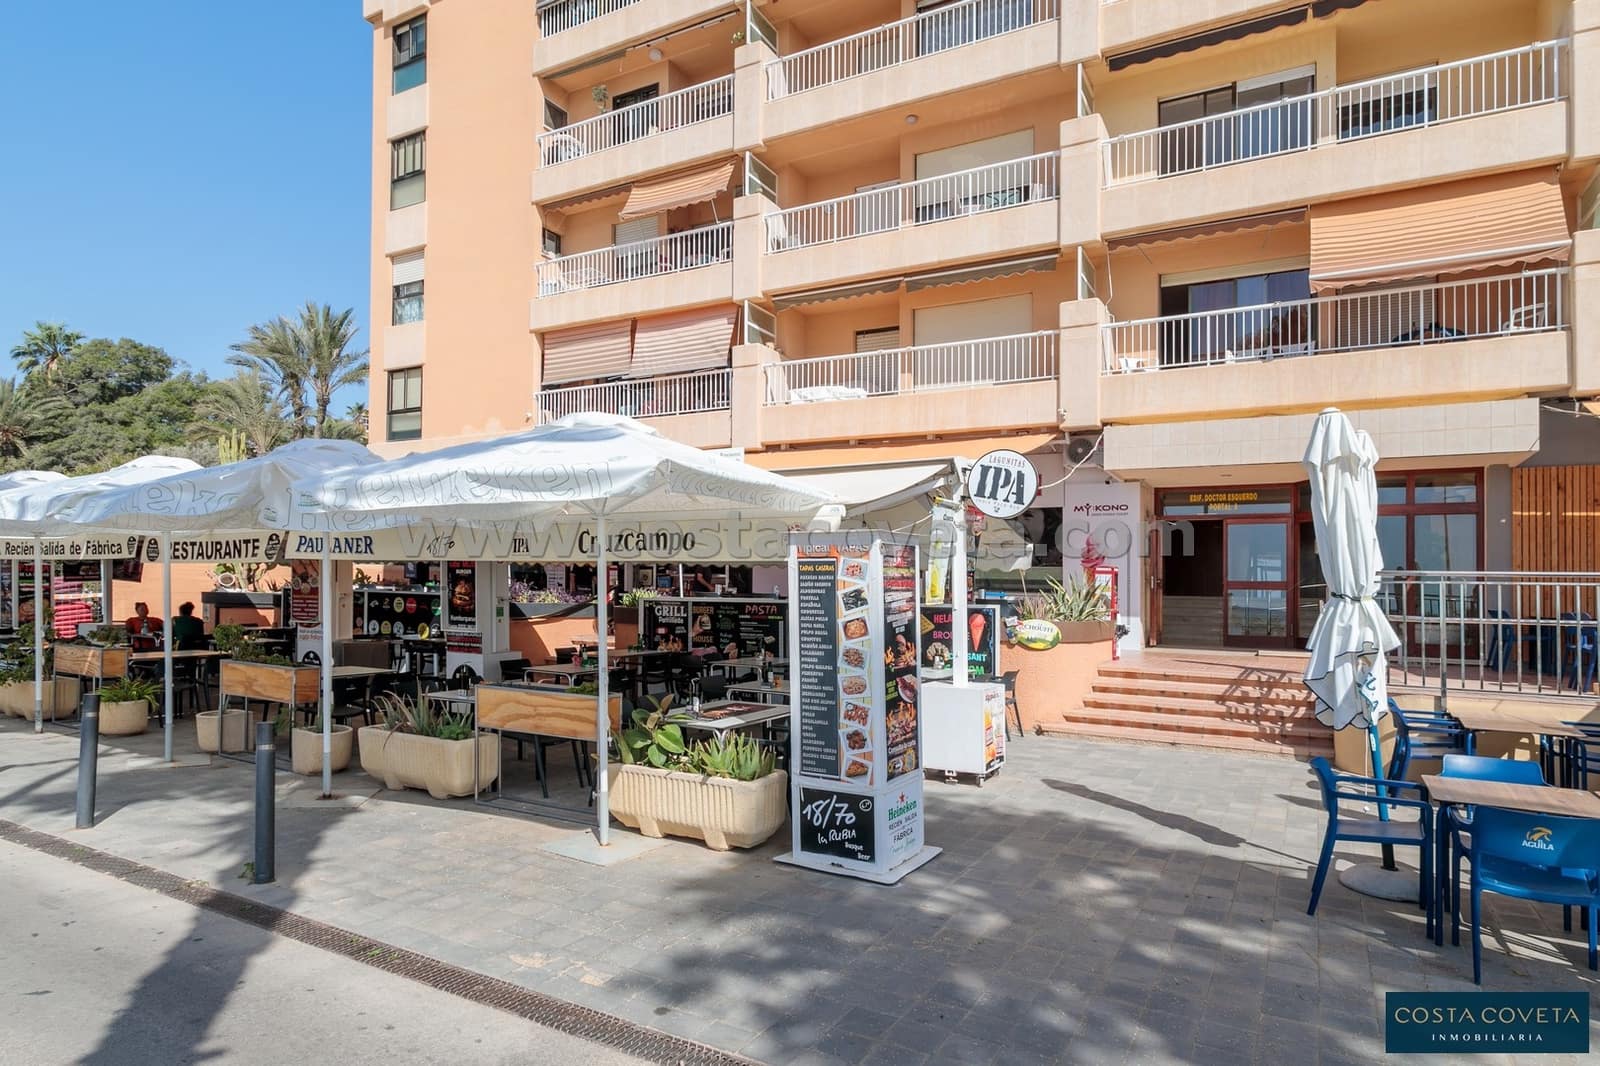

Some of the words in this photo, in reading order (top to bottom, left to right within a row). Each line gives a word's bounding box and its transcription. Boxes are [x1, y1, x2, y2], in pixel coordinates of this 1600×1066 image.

[989, 455, 1026, 468] LAGUNITAS
[974, 464, 1025, 505] IPA
[1204, 493, 1227, 502] DOCTOR
[5, 542, 35, 555] Recién
[69, 541, 81, 555] de
[86, 539, 123, 554] Fábrica
[296, 535, 374, 555] PAUANER
[513, 538, 530, 553] IPA
[578, 530, 696, 555] Cruzcampo
[654, 605, 687, 617] GRILL
[745, 604, 778, 615] PASTA
[802, 794, 856, 829] 18/70
[888, 800, 918, 821] Heineken
[828, 829, 857, 842] RUBIA
